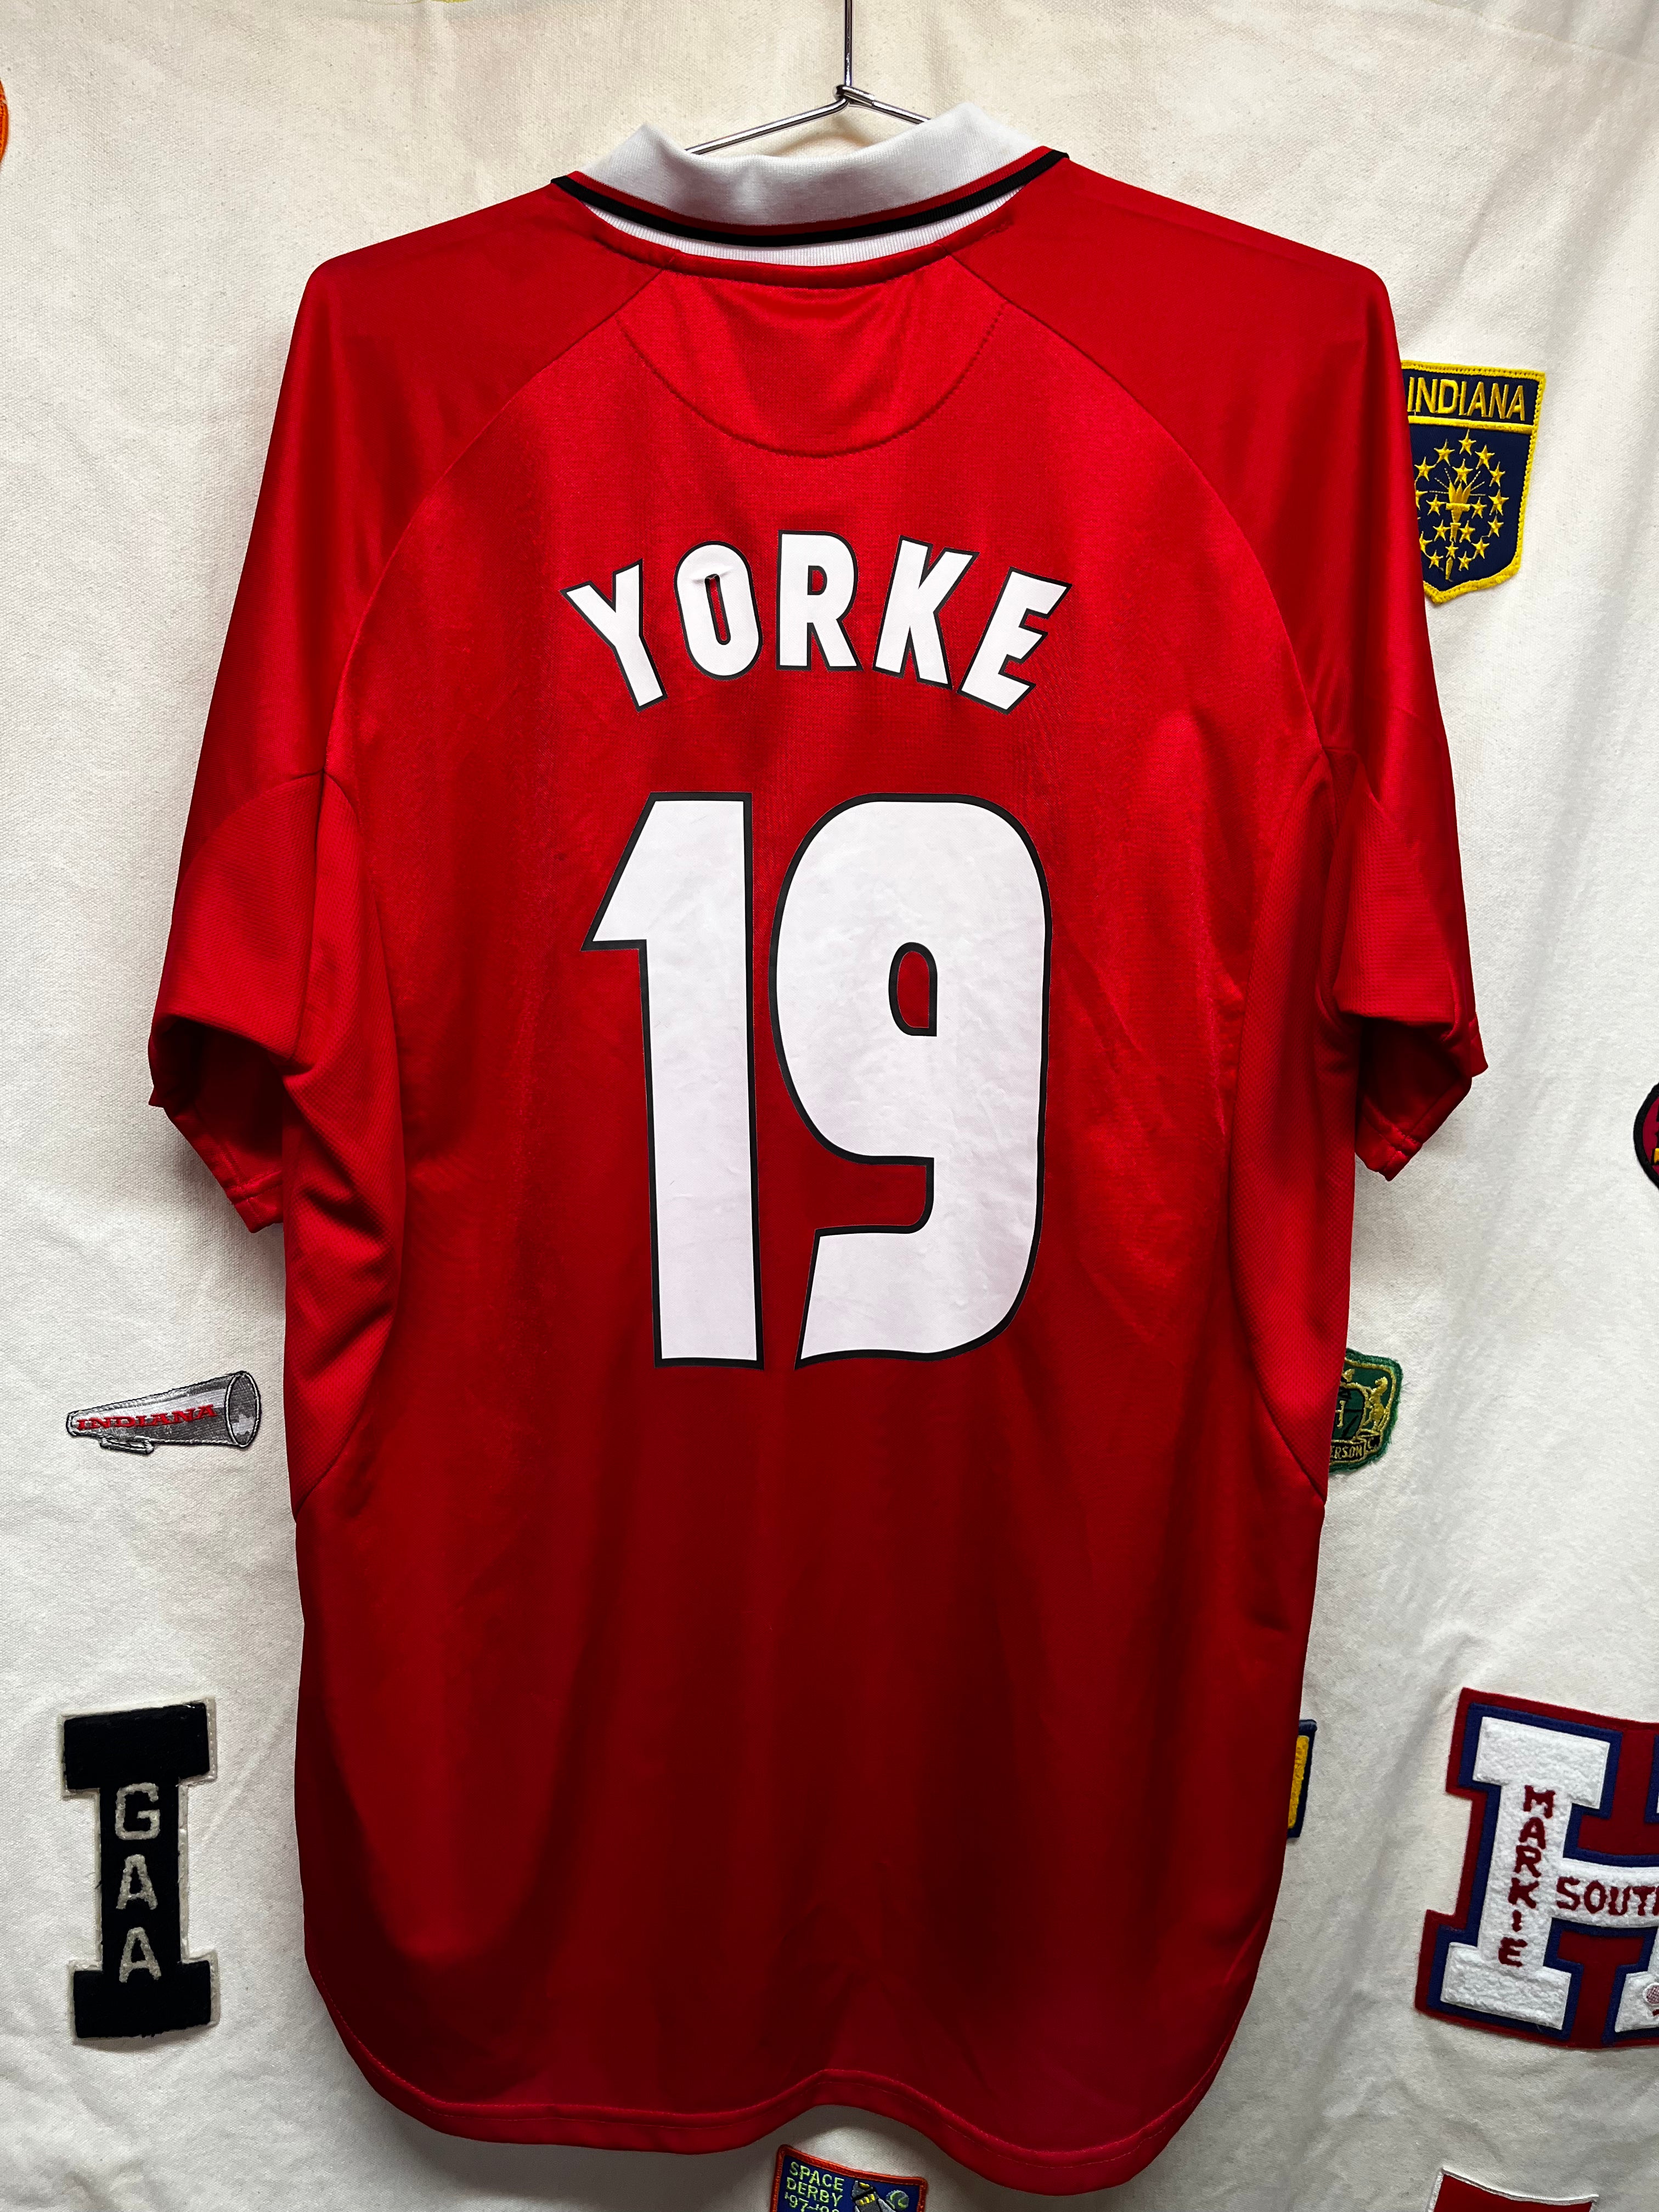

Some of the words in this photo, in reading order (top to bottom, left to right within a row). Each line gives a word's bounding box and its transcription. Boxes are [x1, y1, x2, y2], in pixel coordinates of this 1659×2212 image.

[1407, 376, 1526, 421] INDIANA
[560, 529, 1072, 714] YORKE
[580, 792, 1052, 1370] 19
[76, 1404, 218, 1430] INDIANA
[115, 1782, 161, 1983] GAA
[1498, 1785, 1556, 1968] MARKIE
[787, 2177, 843, 2207] DERBY
[789, 2162, 844, 2192] SPACE
